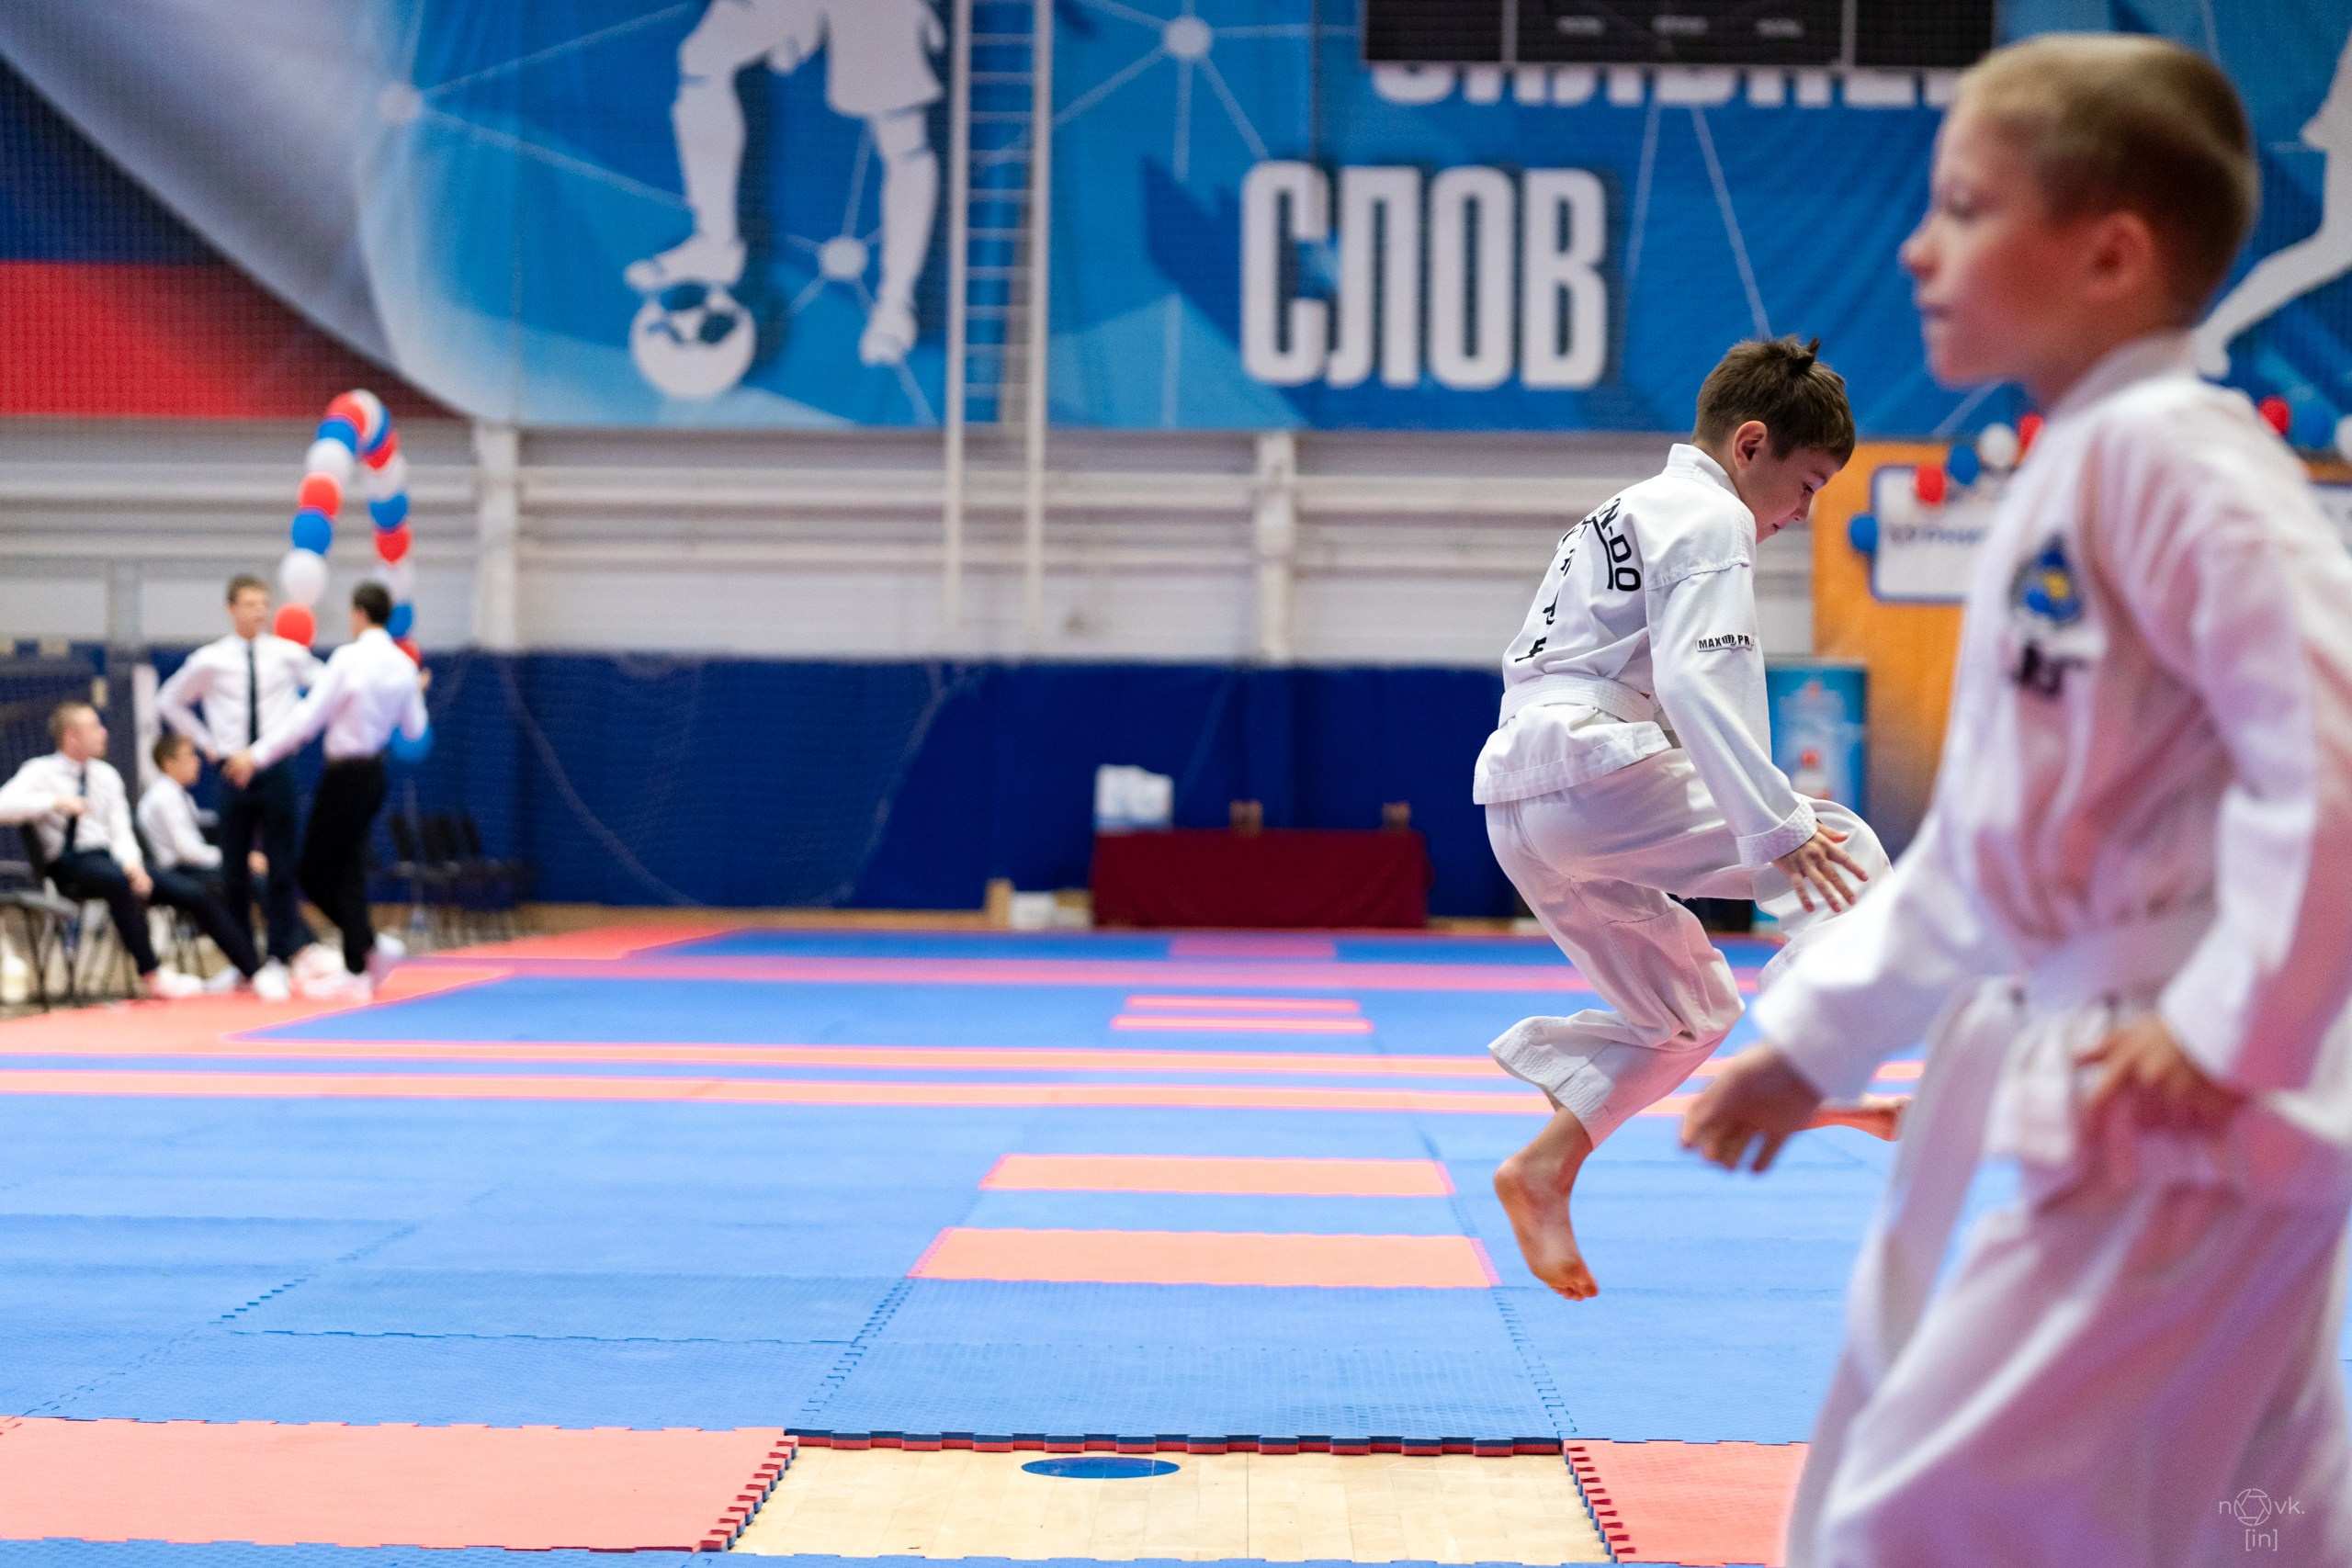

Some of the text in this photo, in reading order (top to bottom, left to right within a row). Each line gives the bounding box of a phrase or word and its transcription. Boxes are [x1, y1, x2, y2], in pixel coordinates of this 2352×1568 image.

[1240, 160, 1608, 390] СЛОВ
[1698, 634, 1755, 649] MAX PR
